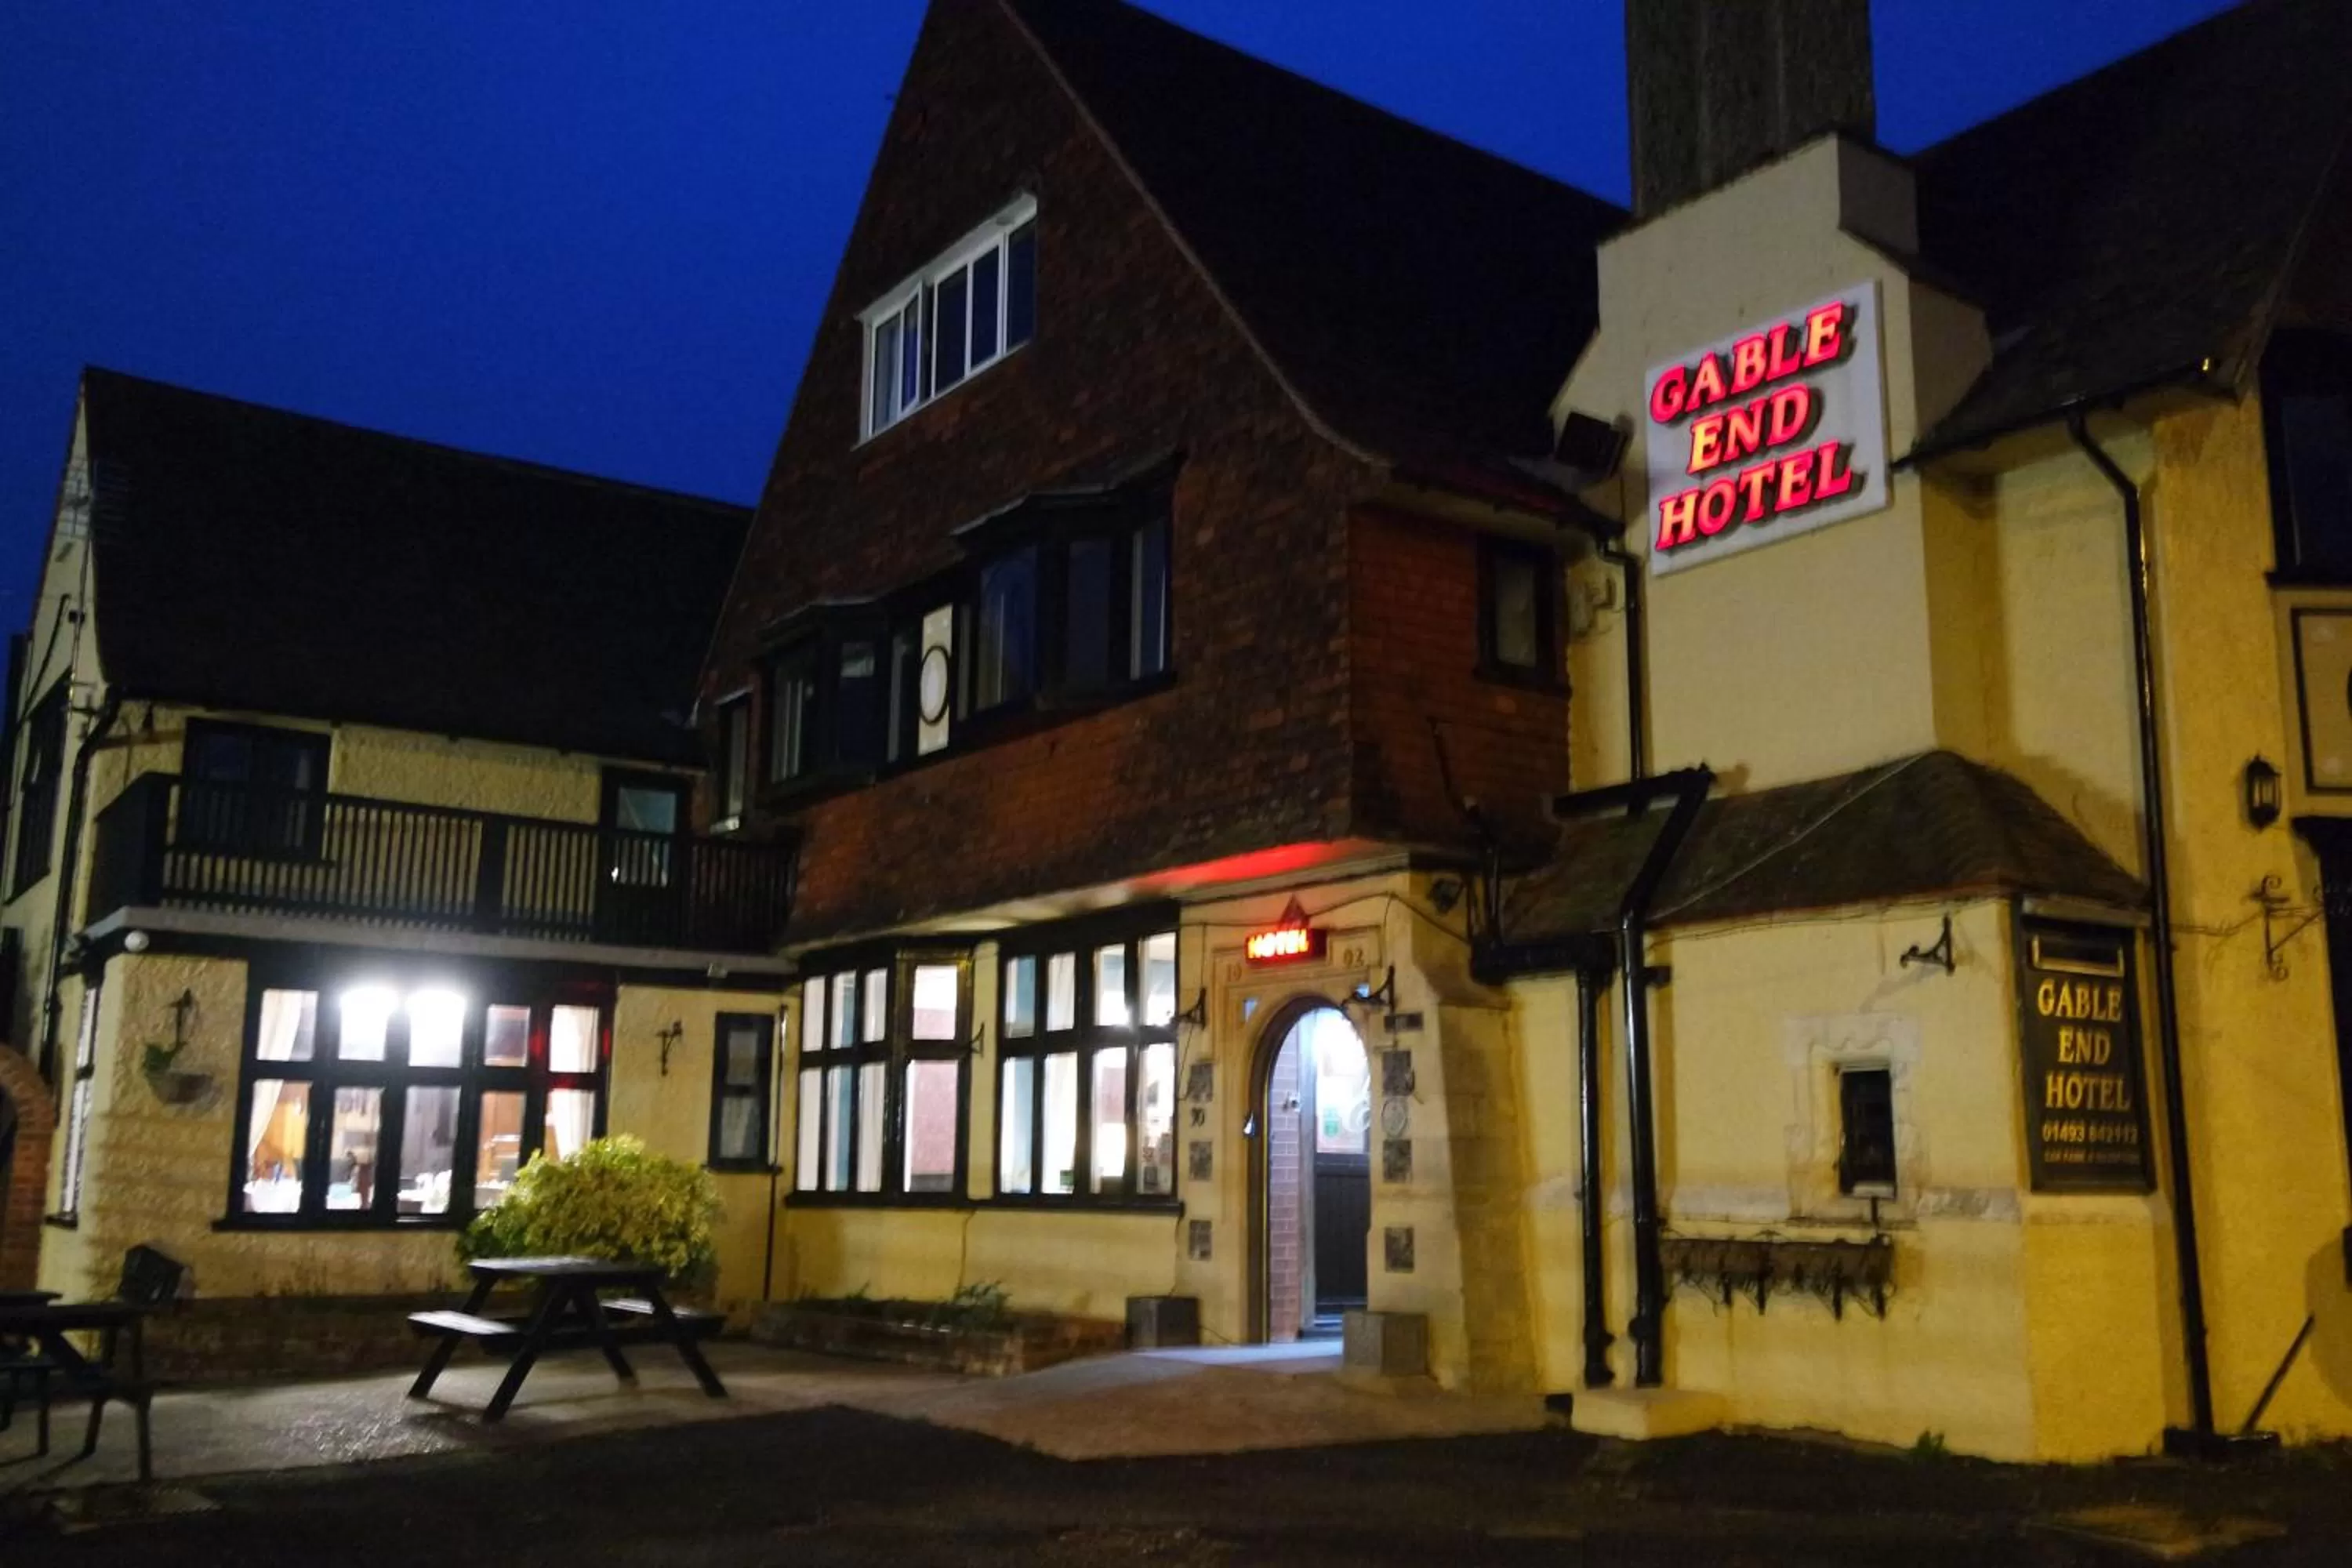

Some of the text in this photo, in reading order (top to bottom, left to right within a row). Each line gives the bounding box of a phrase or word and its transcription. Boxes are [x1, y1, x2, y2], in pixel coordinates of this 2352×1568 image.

[1650, 300, 1843, 423] GABLE
[1687, 382, 1812, 476] END
[1655, 439, 1853, 552] HOTEL
[1248, 929, 1308, 958] HOTEL
[2038, 979, 2122, 1022] GABLE
[2058, 1025, 2111, 1065] END
[2045, 1071, 2130, 1110] HOTEL
